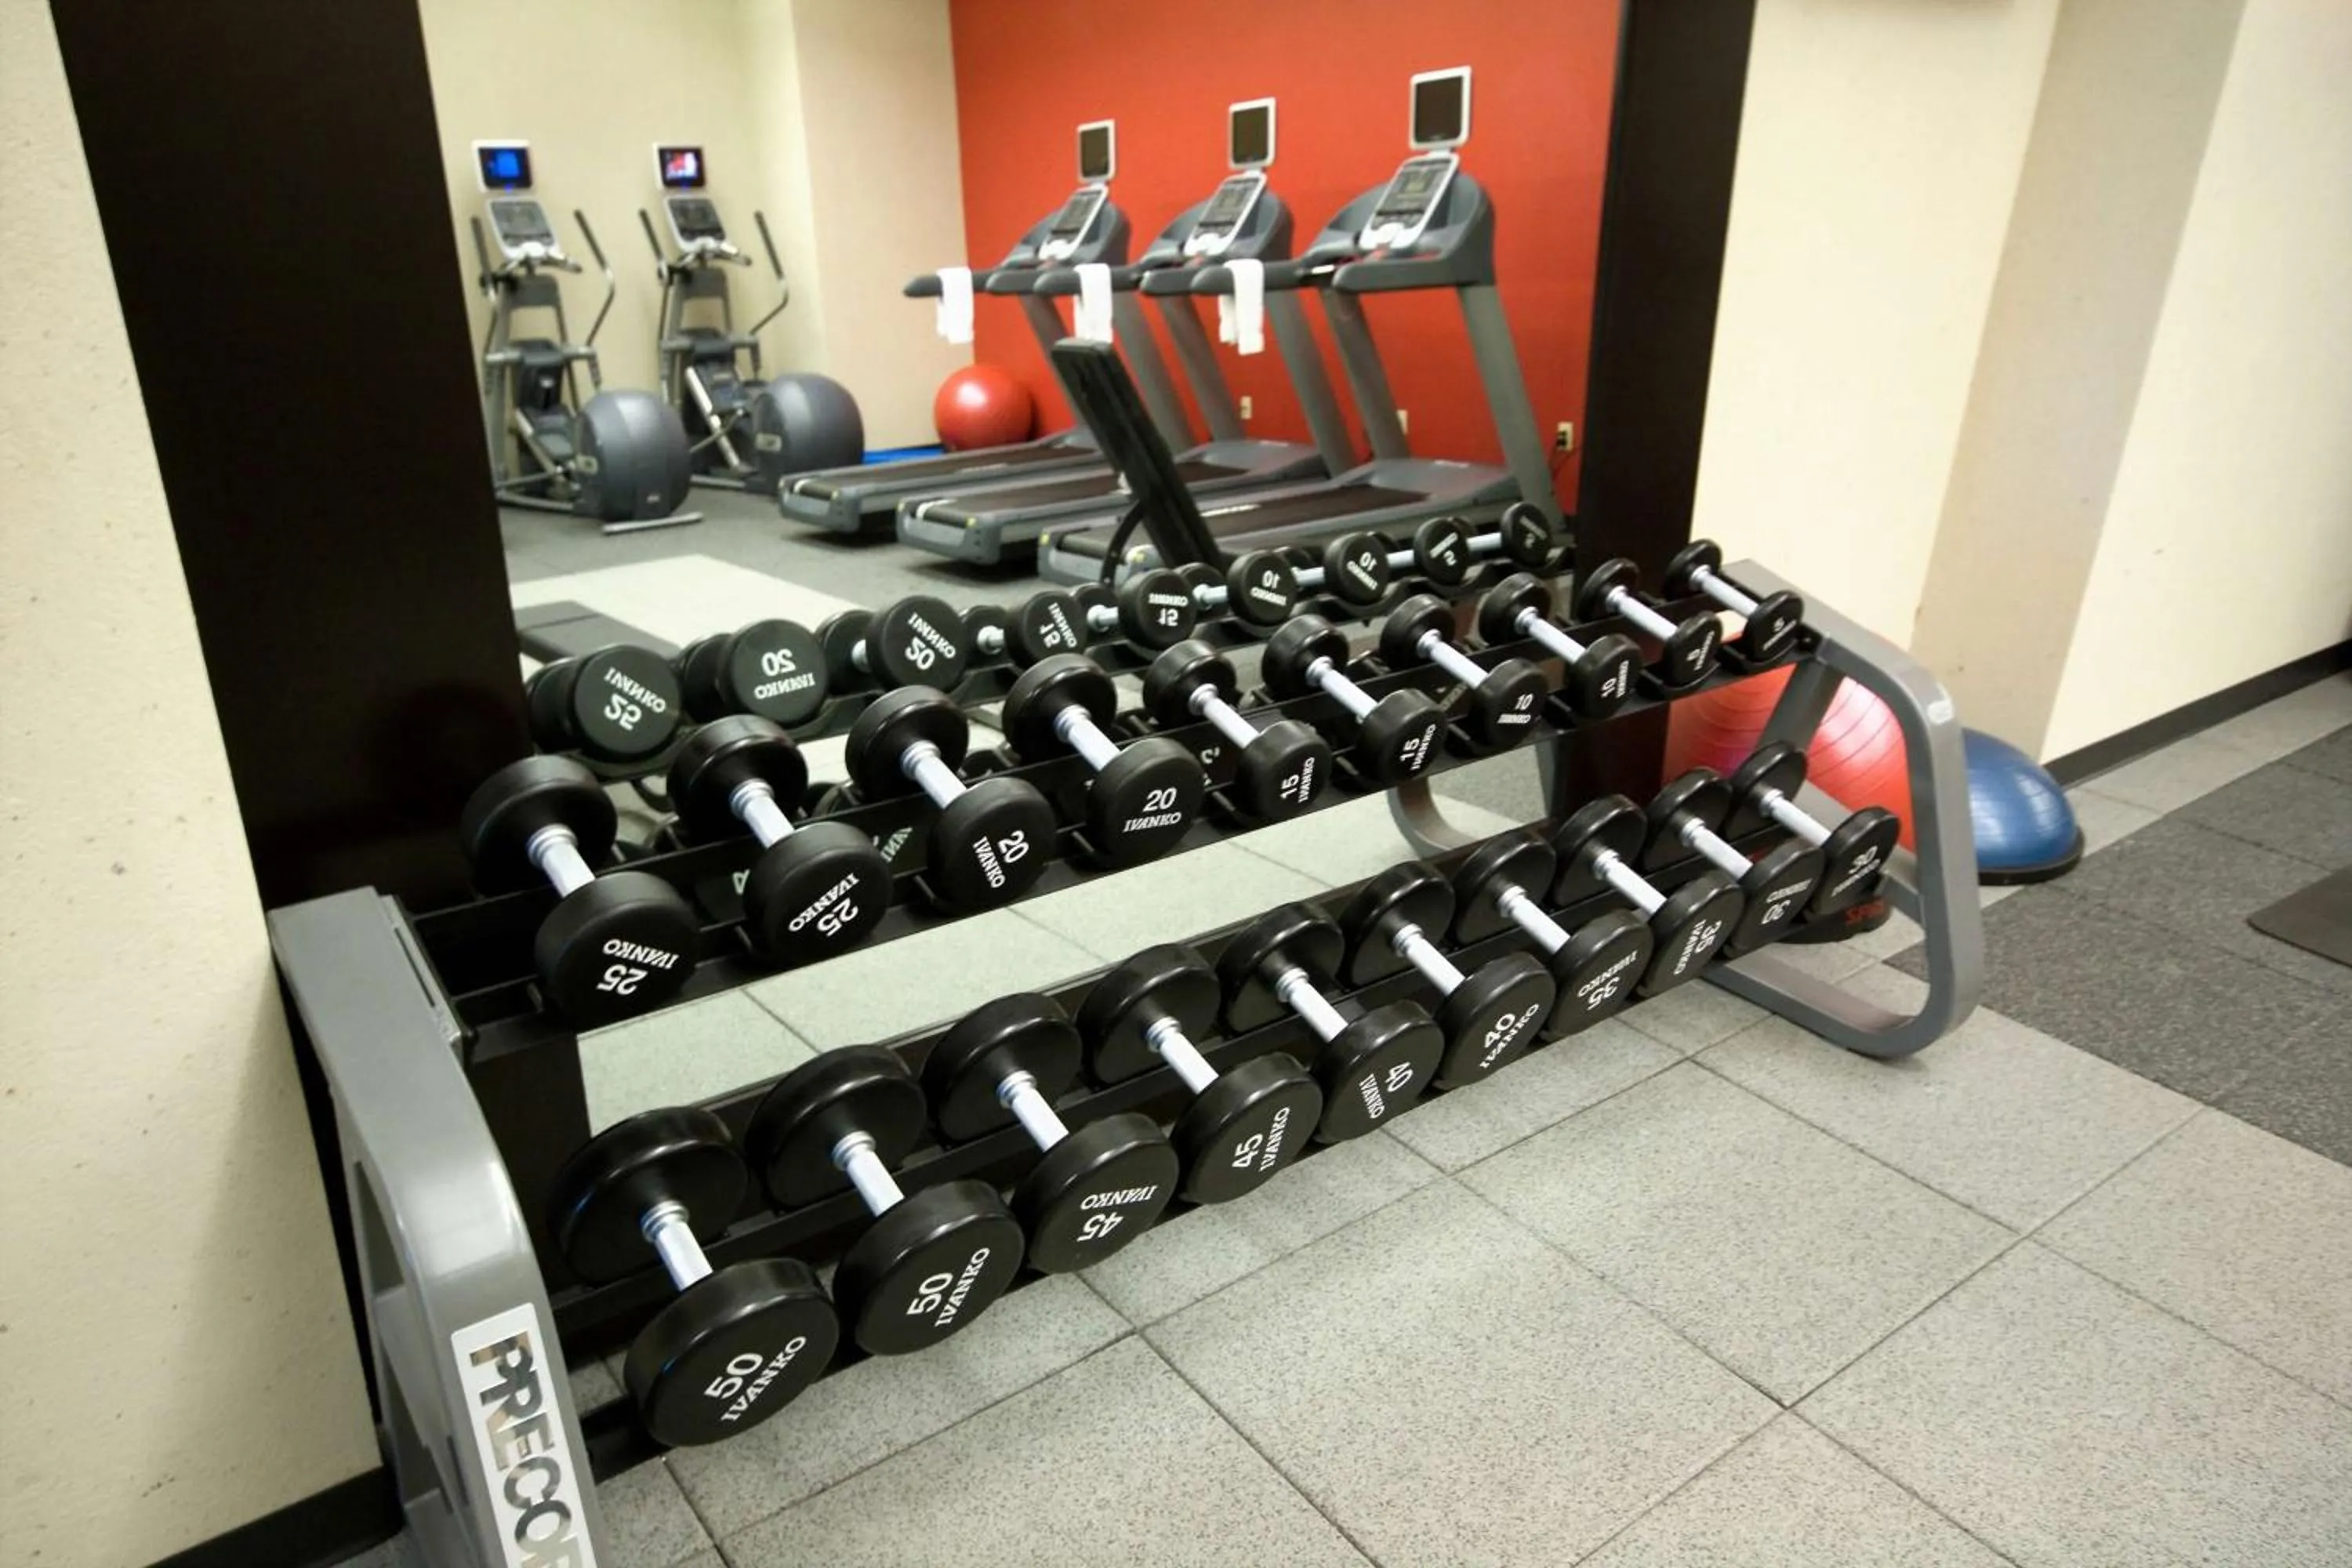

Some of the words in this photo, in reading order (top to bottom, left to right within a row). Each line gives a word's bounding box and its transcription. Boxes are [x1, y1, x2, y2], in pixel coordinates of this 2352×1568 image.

[1515, 694, 1533, 710] 10
[1601, 677, 1617, 698] 10
[1400, 737, 1420, 761] 15
[1280, 774, 1299, 800] 15
[1298, 757, 1314, 803] IVANKO
[1142, 788, 1177, 812] 20
[1123, 811, 1181, 833] IVANKO
[972, 836, 1006, 888] IVANKO
[997, 830, 1029, 863] 20
[788, 873, 859, 932] IVANKO
[817, 898, 858, 936] 25
[602, 938, 679, 969] IVANKO
[597, 964, 648, 995] 25
[1587, 977, 1620, 1011] 35
[1479, 1004, 1539, 1069] IVANKO
[1484, 1014, 1515, 1047] 40
[1385, 1062, 1413, 1091] 40
[1232, 1133, 1263, 1169] 45
[1259, 1107, 1289, 1171] IVANKO
[1080, 1185, 1157, 1209] IVANKO
[1077, 1212, 1123, 1242] 45
[907, 1272, 953, 1315] 50
[935, 1247, 989, 1327] IVANKO
[705, 1352, 763, 1399] 50
[721, 1335, 806, 1421] IVANKO
